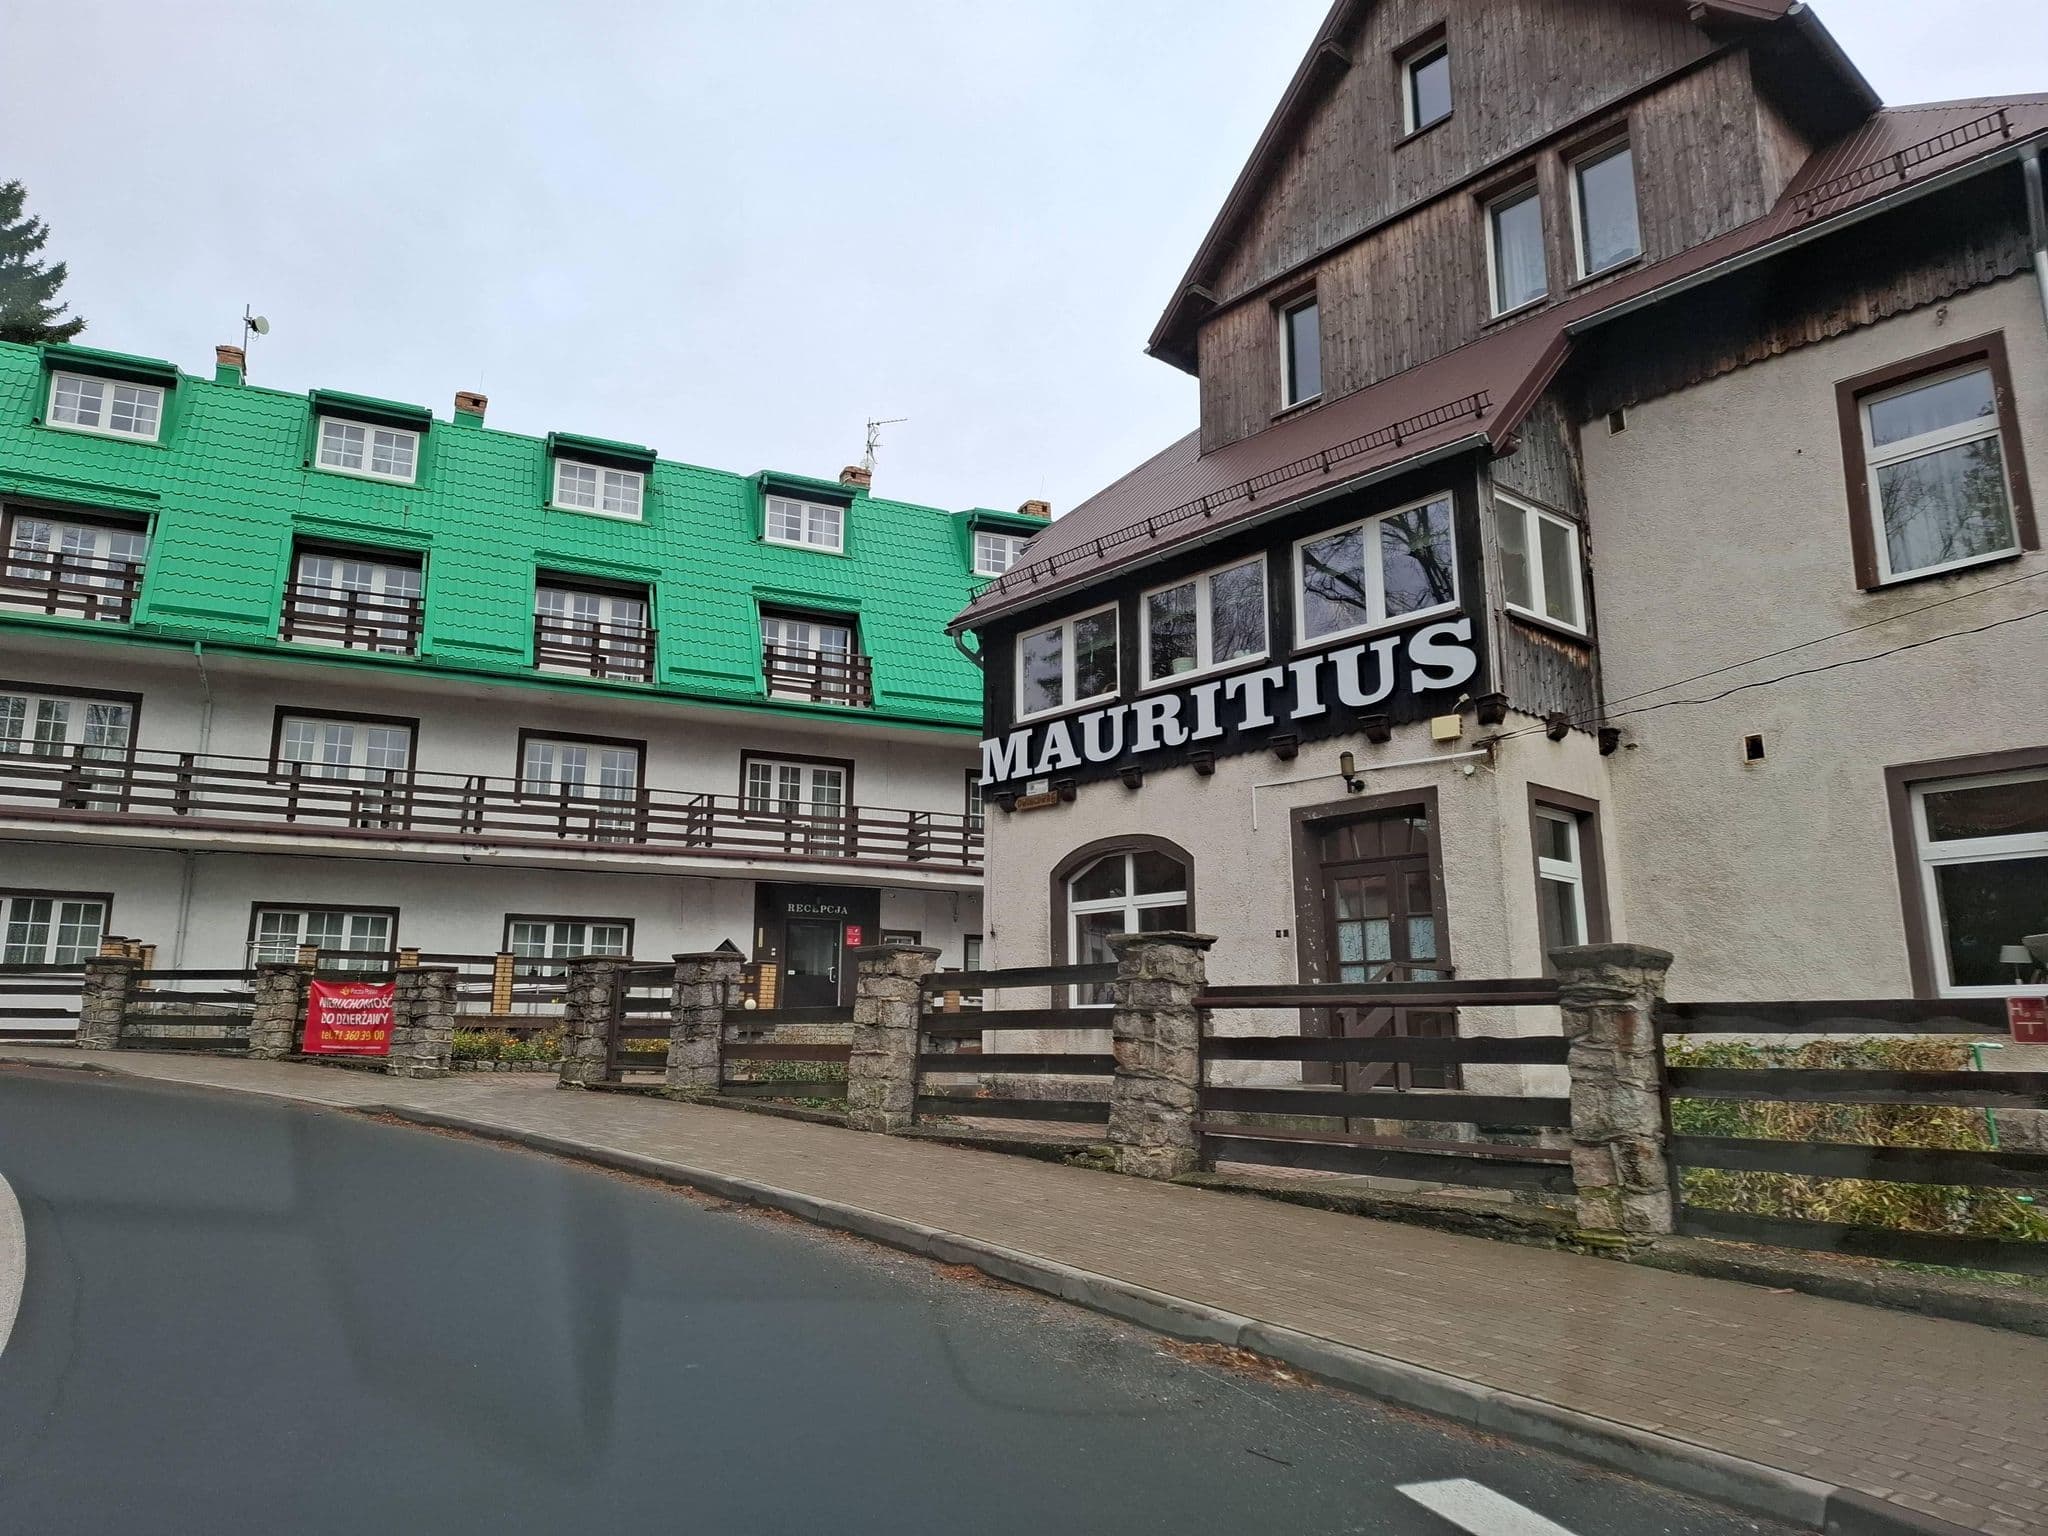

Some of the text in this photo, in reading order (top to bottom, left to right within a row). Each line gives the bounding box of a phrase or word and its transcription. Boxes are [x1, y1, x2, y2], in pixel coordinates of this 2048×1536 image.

[979, 617, 1479, 786] MAURITIUS
[319, 994, 393, 1010] NIERUCHOMOŚĆ
[336, 1011, 389, 1025] DZIERŻAWY
